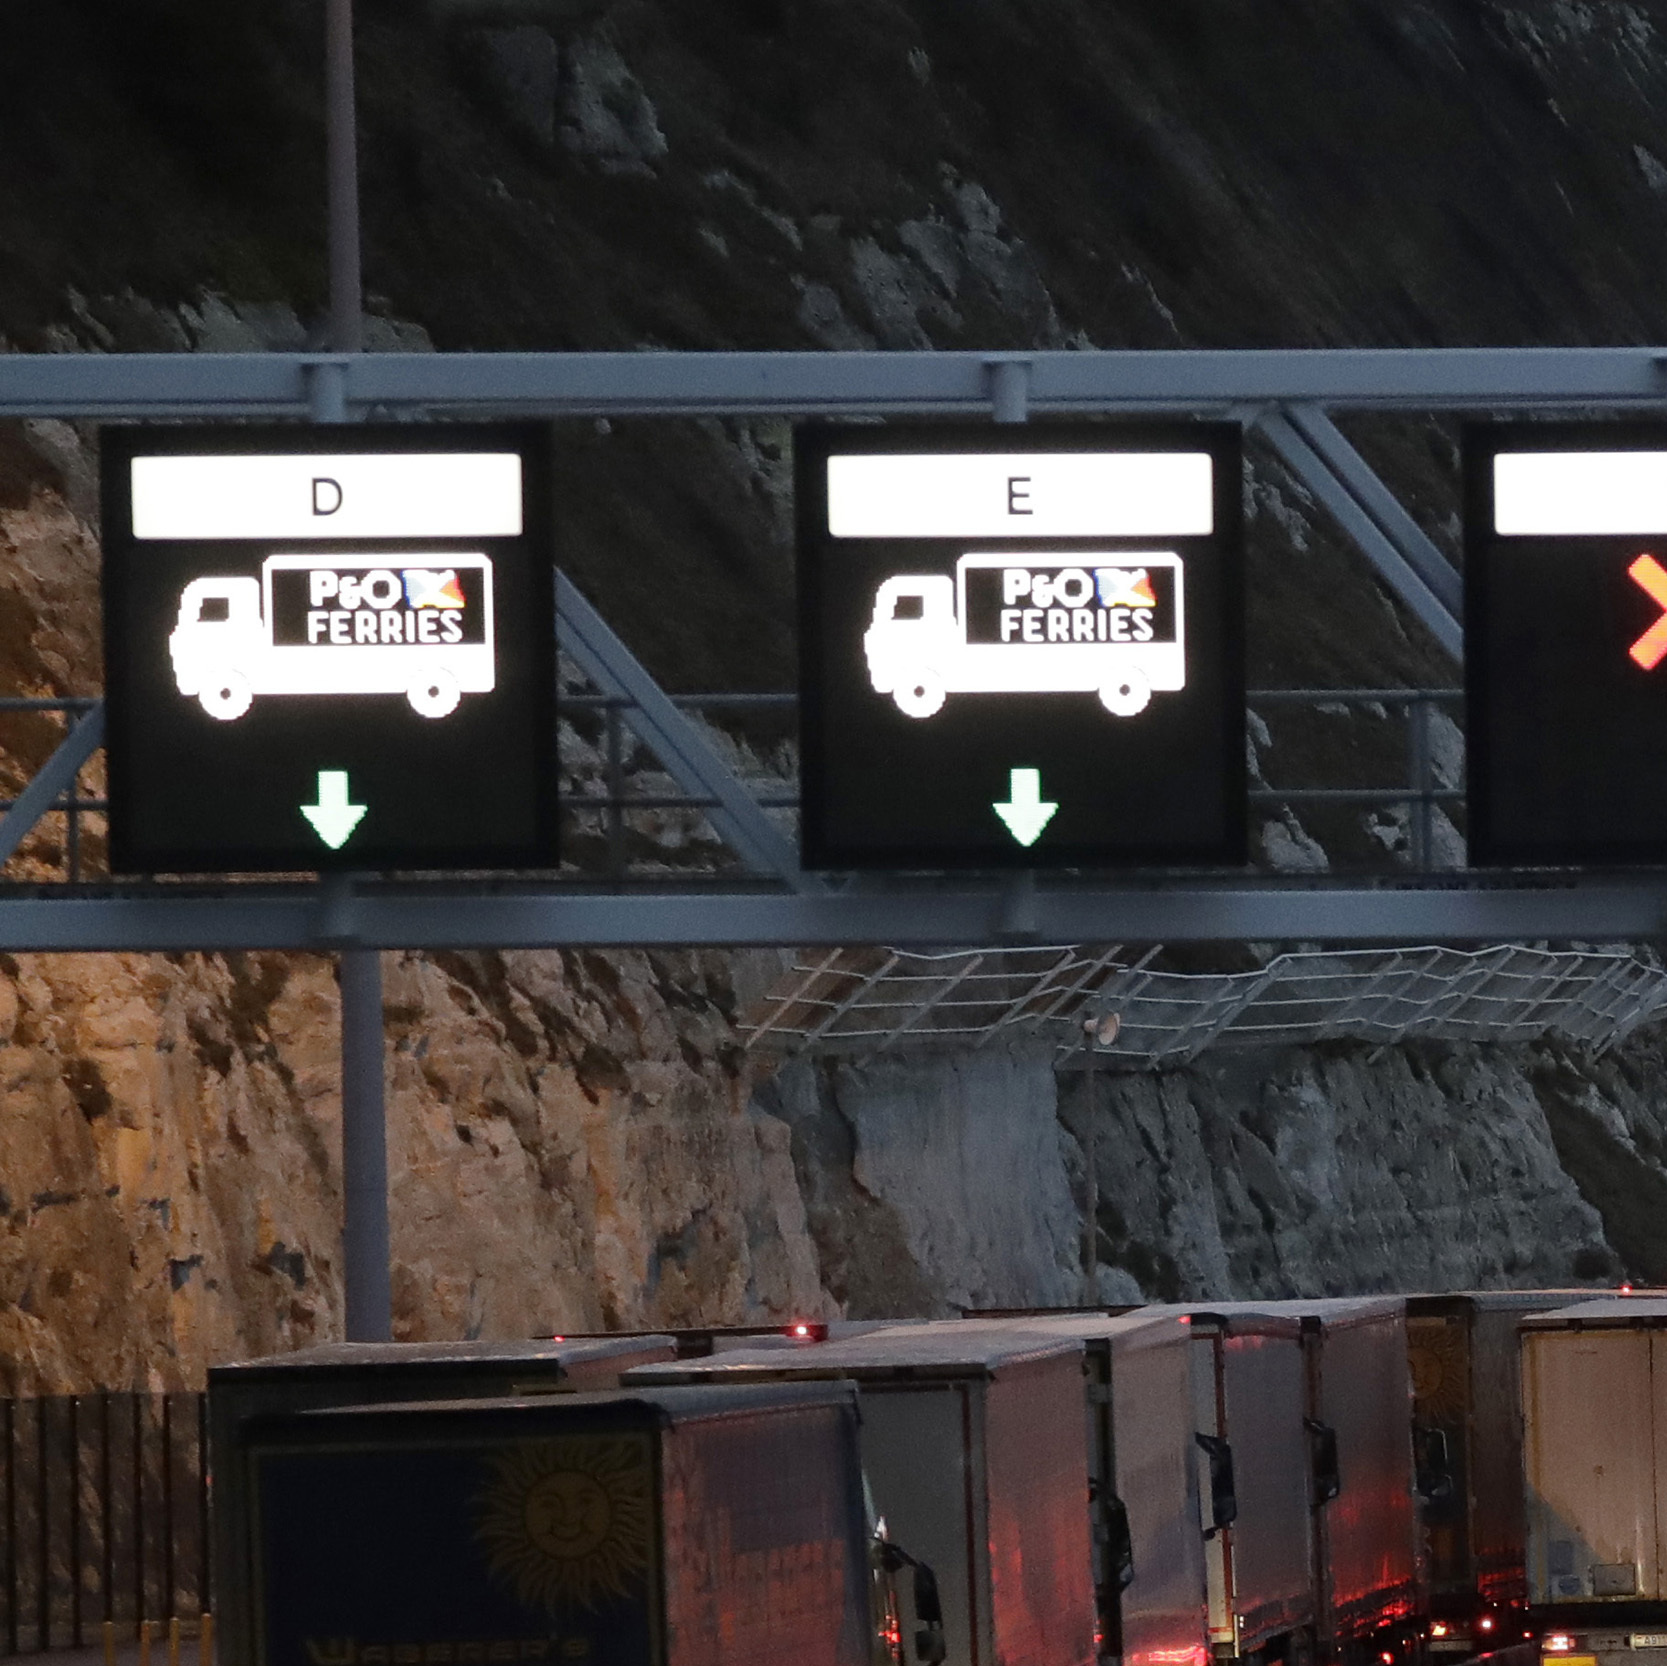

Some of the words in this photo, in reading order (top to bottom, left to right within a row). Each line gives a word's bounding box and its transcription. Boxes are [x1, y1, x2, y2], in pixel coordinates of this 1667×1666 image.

[310, 479, 344, 517] D
[1007, 477, 1033, 515] E
[309, 568, 403, 608] P&O
[1002, 567, 1094, 607] P&O
[307, 608, 464, 645] FERRIES
[1000, 607, 1155, 644] FERRIES
